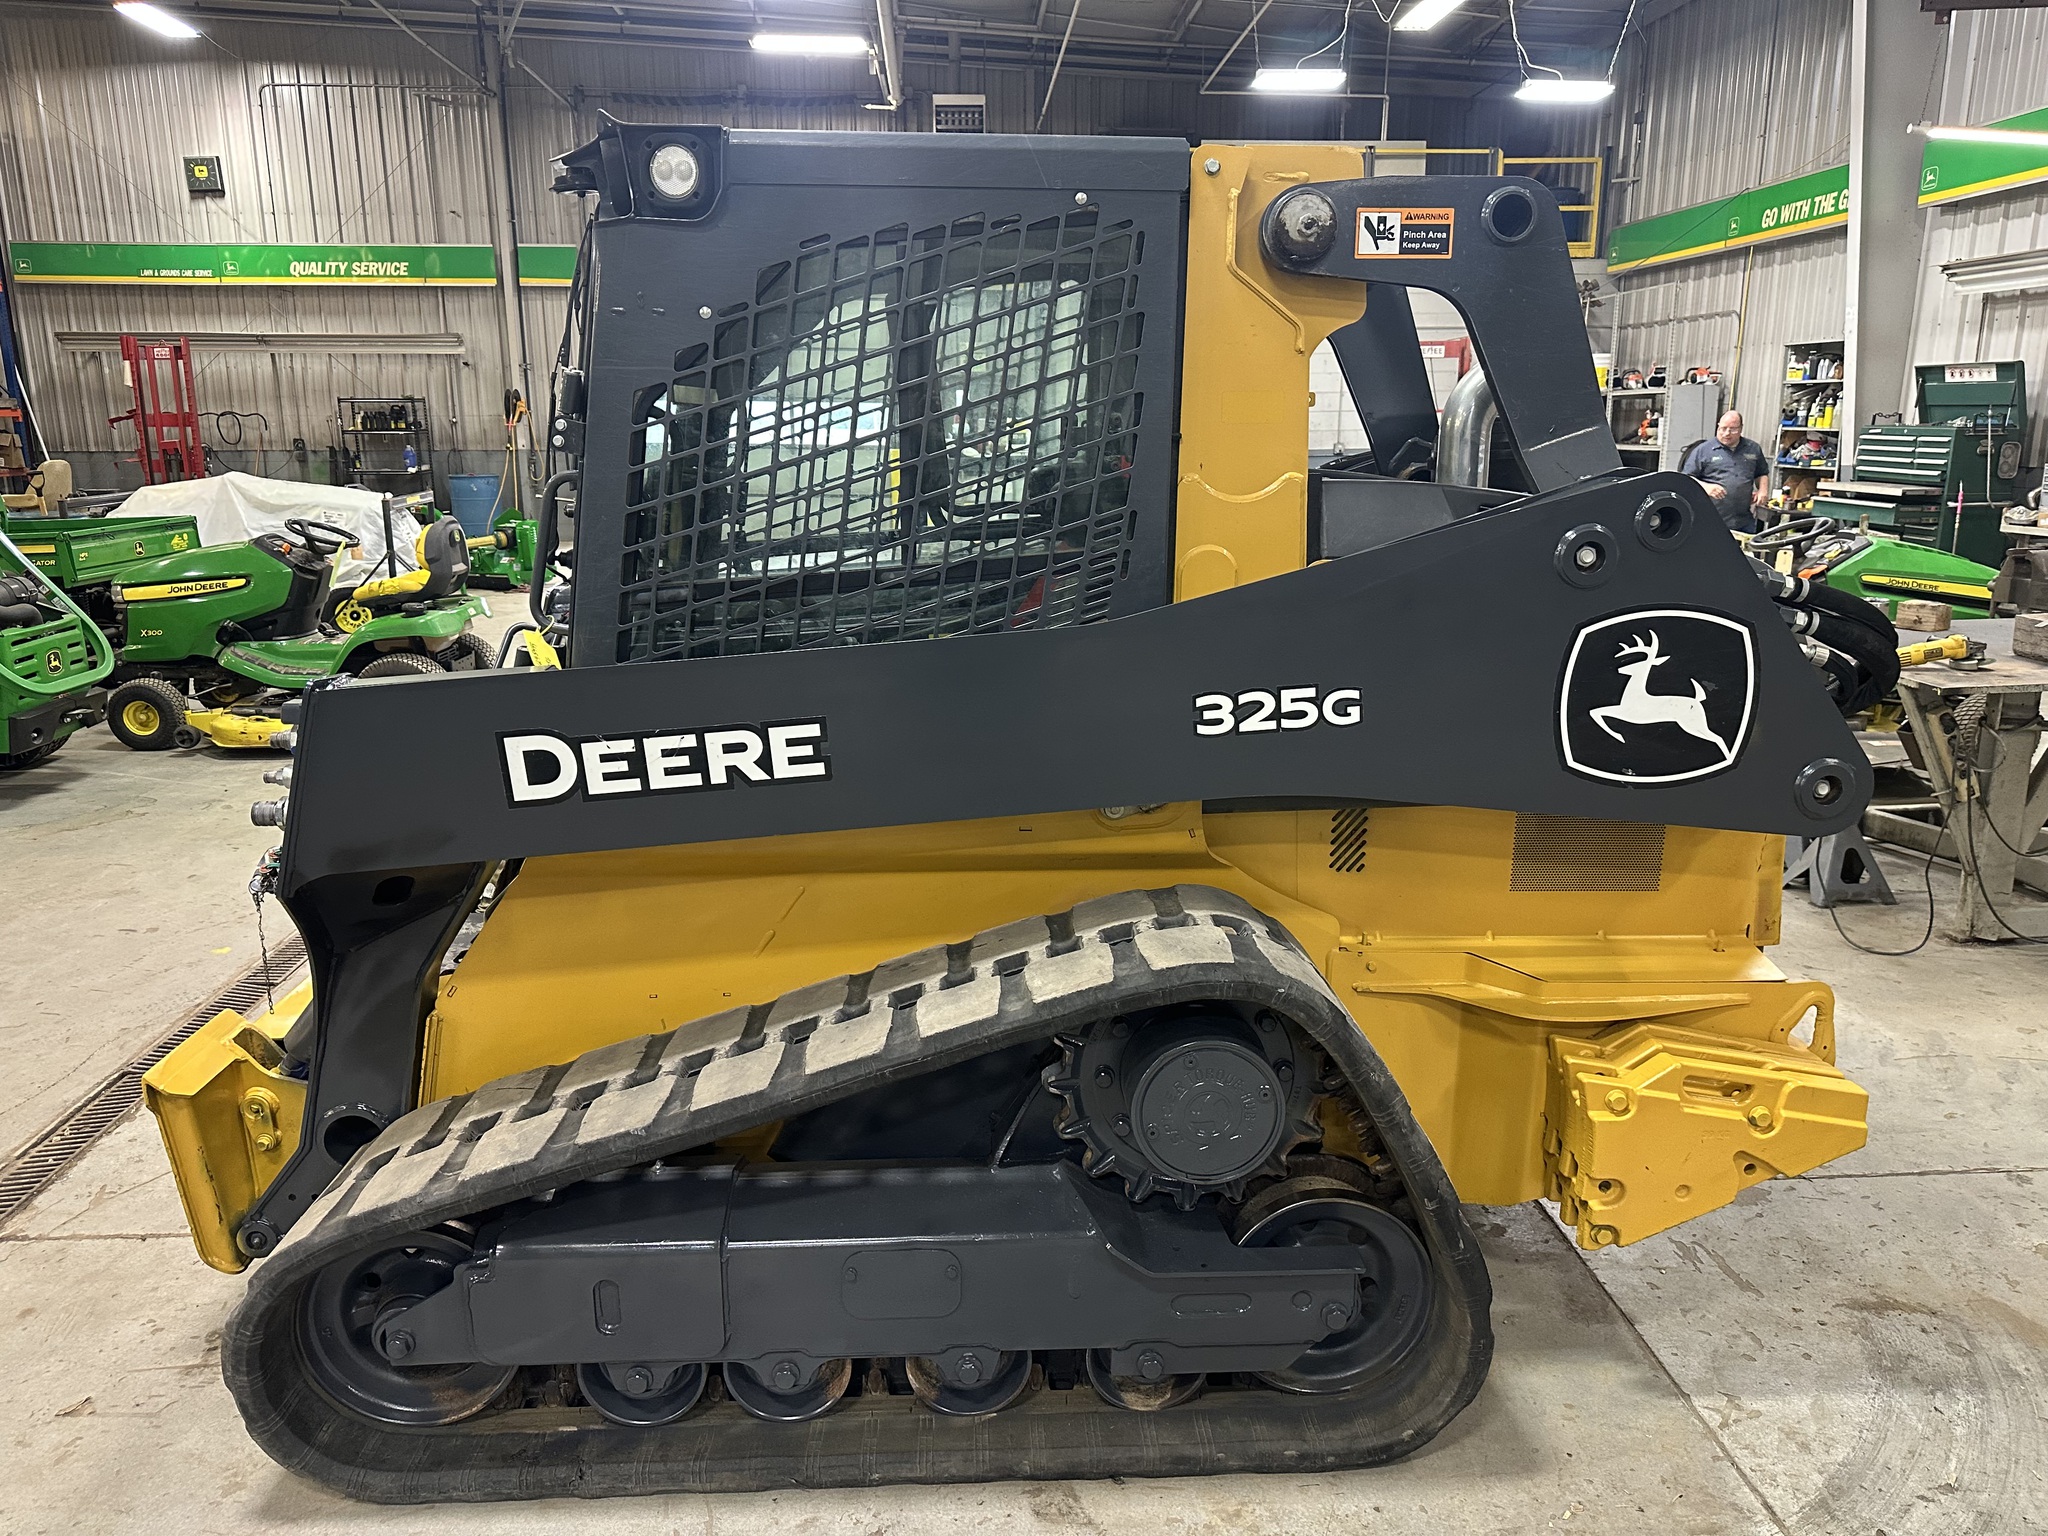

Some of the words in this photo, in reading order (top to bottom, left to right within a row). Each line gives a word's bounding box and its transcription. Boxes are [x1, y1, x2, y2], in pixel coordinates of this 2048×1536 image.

[1761, 207, 1778, 228] GO
[1780, 198, 1811, 224] WITH
[1813, 191, 1838, 216] THE
[1838, 188, 1849, 210] G
[1403, 231, 1426, 239] Pinch
[1427, 231, 1447, 239] Area
[1402, 242, 1420, 250] Keep
[1421, 242, 1440, 250] Away
[140, 269, 153, 277] LAWN
[154, 269, 159, 277] &
[160, 269, 180, 277] GROUNDS
[181, 269, 193, 277] CARE
[194, 269, 213, 277] SERVICE
[289, 261, 348, 277] QUALITY
[351, 261, 409, 276] SERVICE
[167, 585, 193, 594] JOHN
[194, 581, 228, 591] DEERE
[1886, 577, 1910, 587] JOHN
[1911, 580, 1940, 592] DEERE
[140, 629, 163, 637] X300
[1195, 687, 1361, 735] 325G
[503, 723, 826, 802] DEERE
